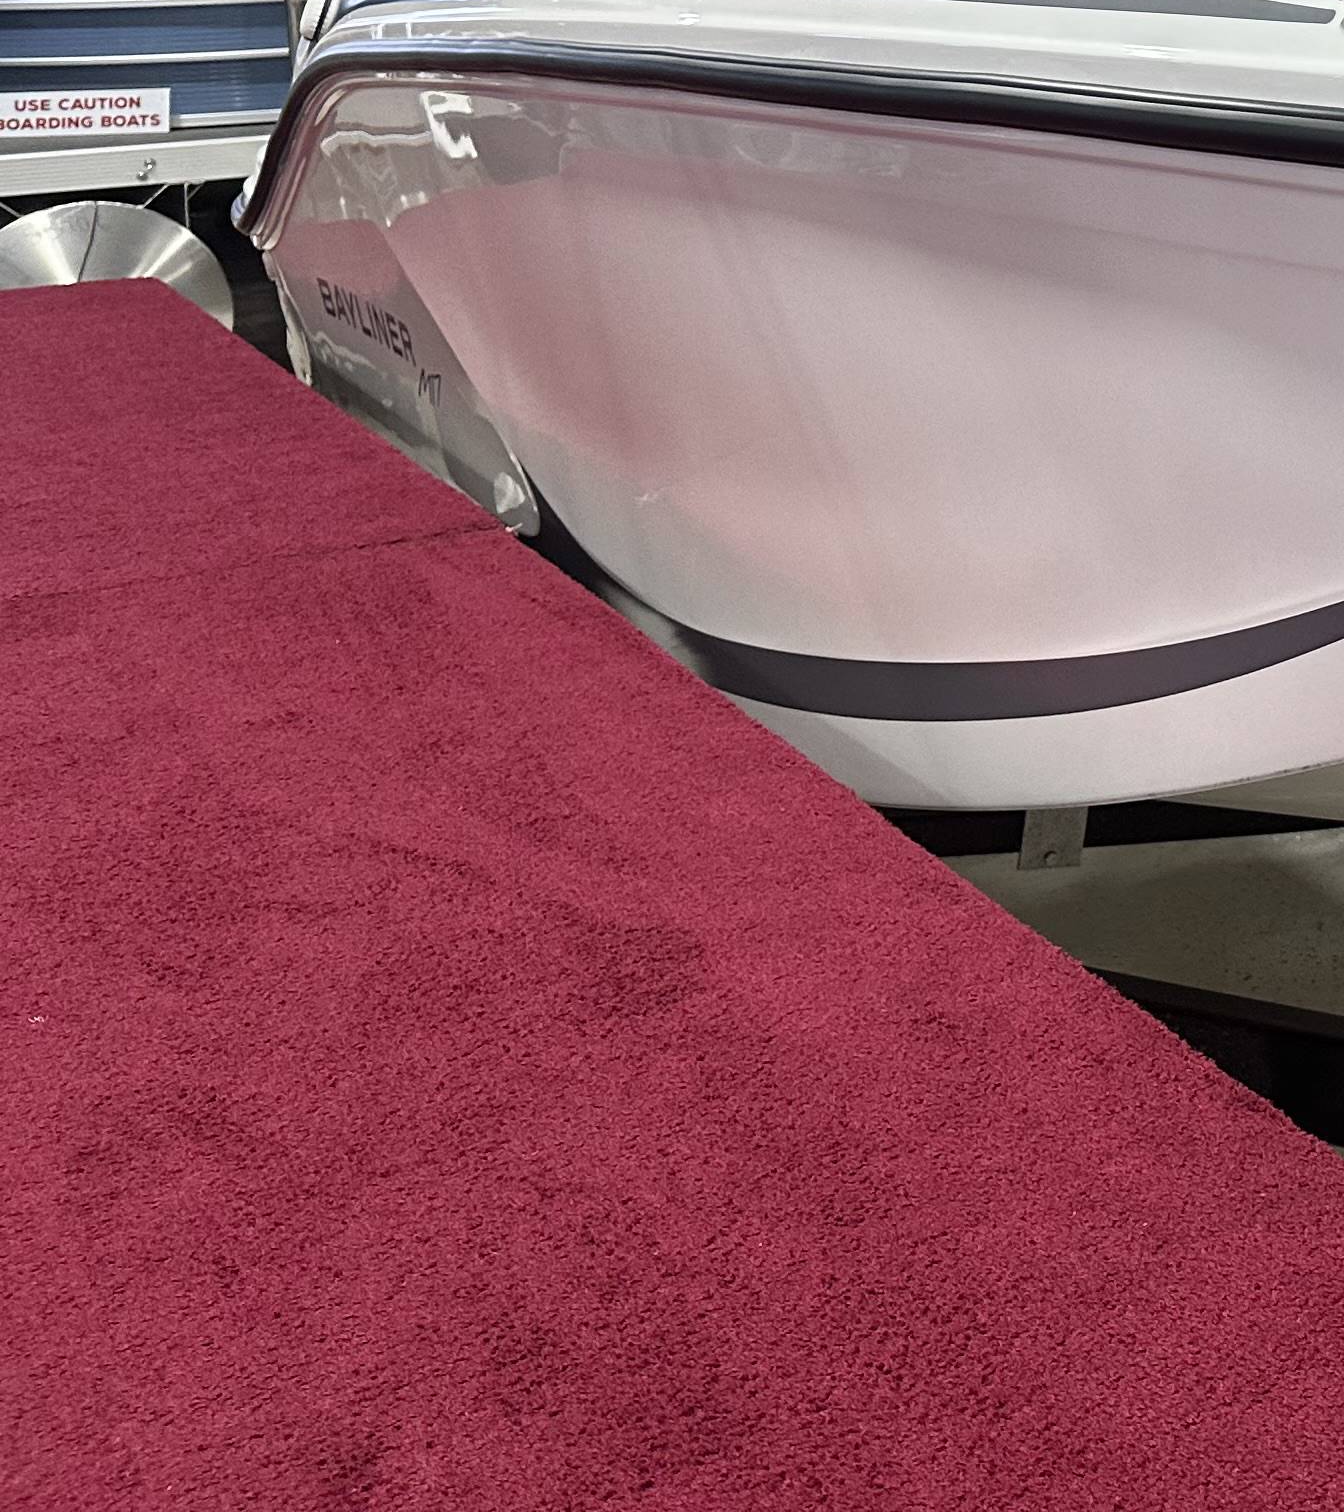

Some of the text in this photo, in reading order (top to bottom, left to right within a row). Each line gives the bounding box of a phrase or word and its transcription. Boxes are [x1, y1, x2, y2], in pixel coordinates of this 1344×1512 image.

[14, 96, 141, 112] USE CAUTION
[0, 114, 161, 131] BOARDING BOATS
[316, 277, 416, 367] BAYLINER
